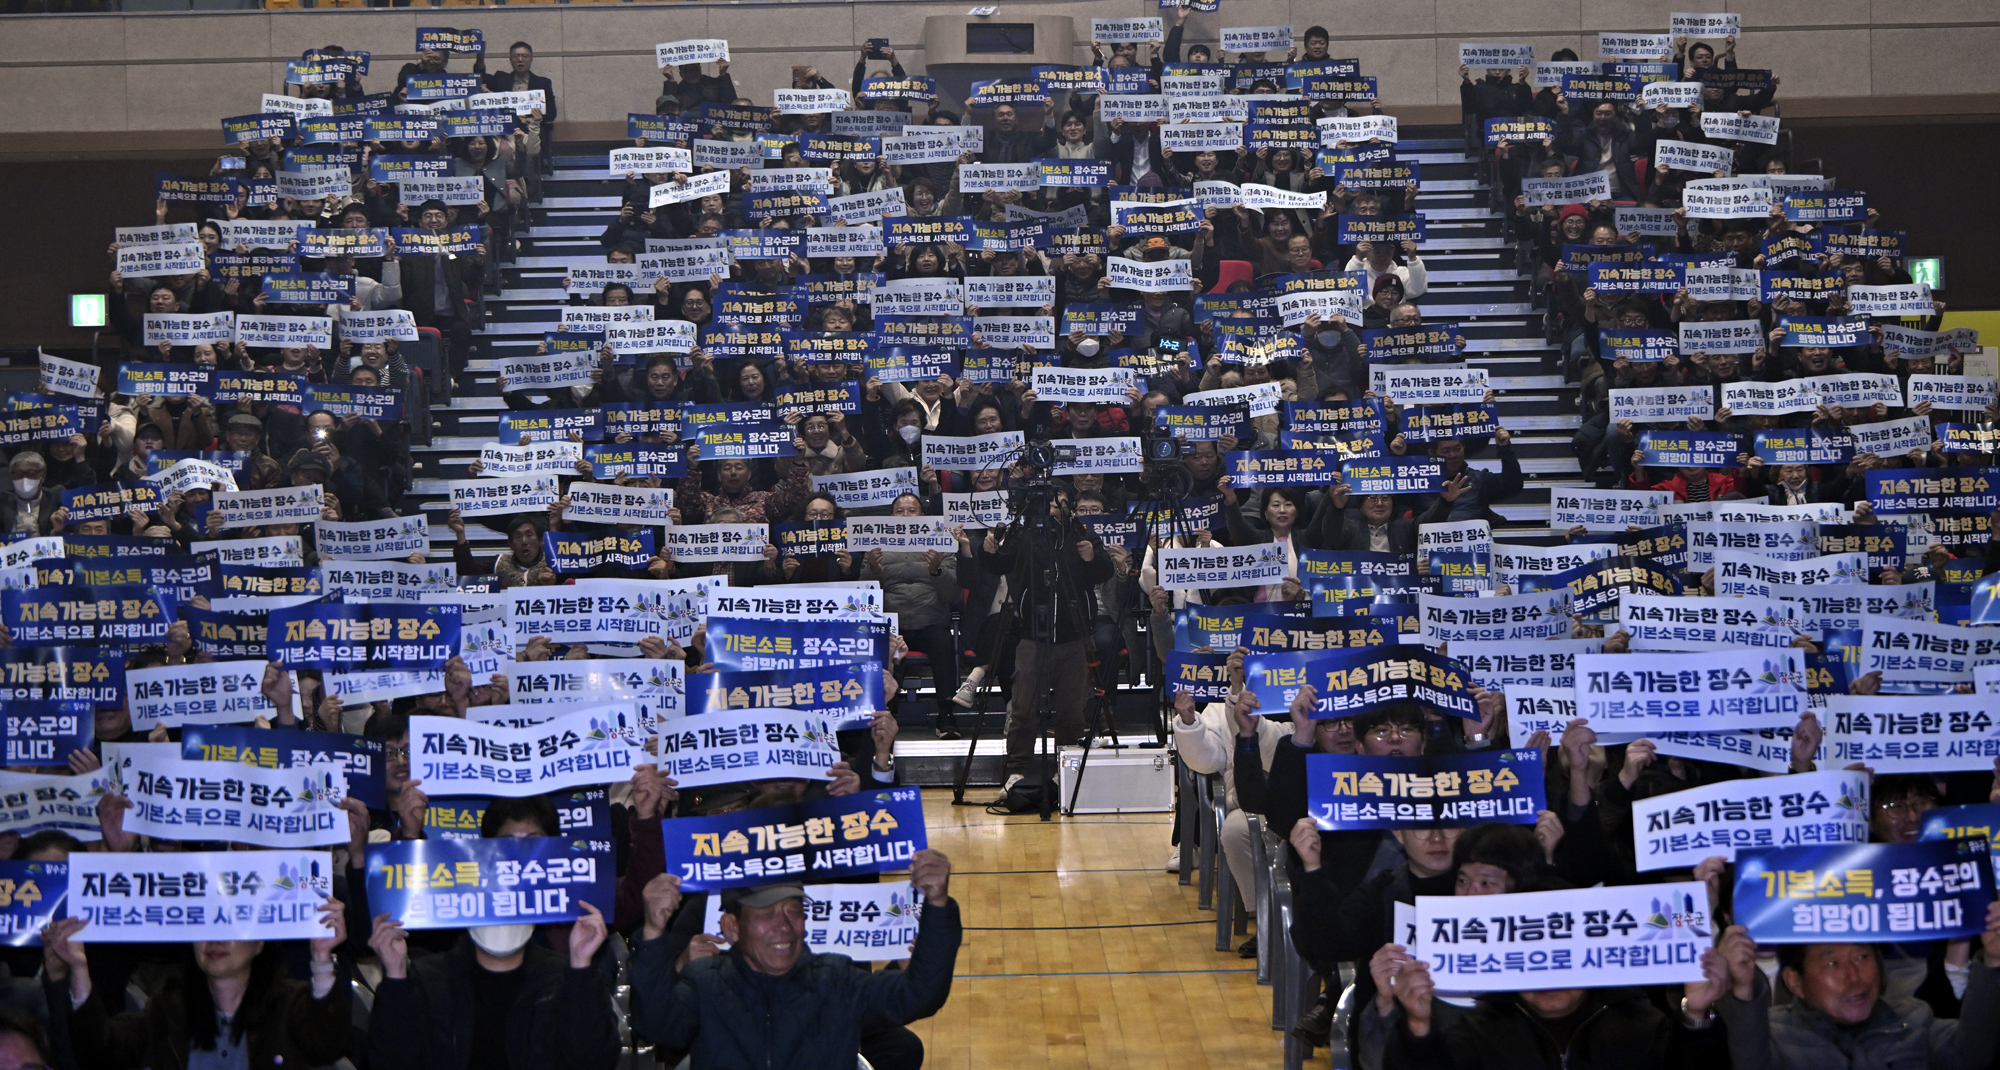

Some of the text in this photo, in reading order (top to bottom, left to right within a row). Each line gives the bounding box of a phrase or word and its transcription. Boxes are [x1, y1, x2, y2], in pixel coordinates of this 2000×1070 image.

[1673, 18, 1706, 26] 지속가능한
[1224, 31, 1275, 41] 지속가능한 장수
[614, 152, 671, 162] 지속가능한 장수
[614, 161, 688, 170] 기본소득으로 시작합니다
[963, 169, 1023, 178] 지속가능한 장수
[1006, 179, 1037, 187] 시작합니다
[1687, 195, 1749, 204] 지속가능한 장수
[892, 223, 963, 234] 지속가능한 장수
[888, 234, 969, 243] 기본소득으로 시작합니다
[1598, 269, 1675, 279] 지속가능한 장수
[1593, 281, 1681, 290] 기본소득으로 시작합니다
[241, 321, 307, 332] 지속가능한 장수
[884, 323, 963, 334] 지속가능한 장수
[240, 333, 326, 343] 기본소득으로 시작합니다
[879, 337, 968, 346] 기본소득으로 시작합니다
[126, 370, 208, 382] 기본소득, 장수군의
[1037, 374, 1108, 386] 지속가능한 장수
[1391, 376, 1463, 388] 지속가능한 장수
[135, 383, 196, 394] 희망이 됩니다
[1037, 387, 1084, 396] 기본소득으로
[1391, 388, 1484, 398] 기본소득으로 시작합니다
[703, 432, 790, 444] 기본소득, 장수군의
[1648, 440, 1737, 451] 기본소득, 장수군의
[714, 444, 779, 456] 희망이 됩니다
[1659, 452, 1725, 463] 희망이 됩니다
[1236, 459, 1324, 471] 지속가능한 장수
[1348, 466, 1440, 478] 기본소득, 장수군의
[1231, 472, 1331, 484] 기본소득으로 시작합니다
[1361, 479, 1429, 491] 희망이 됩니다
[1880, 477, 1989, 494] 지속가능한 장수
[454, 484, 531, 499] 지속가능한 장수
[456, 497, 554, 511] 기본소득으로 시작합니다
[1874, 496, 1997, 509] 기본소득으로 시작합니다
[319, 528, 398, 542] 지속가능한 장수
[319, 539, 423, 554] 기본소득으로 시작합니다
[1164, 553, 1256, 570] 지속가능한 장수
[1166, 567, 1281, 583] 기본소득으로 시작합니다
[20, 600, 159, 621] 지속가능한 장수
[515, 596, 630, 616] 지속가능한 장수
[1628, 606, 1758, 626] 지속가능한 장수
[11, 623, 168, 641] 기본소득으로 시작합니다
[286, 617, 441, 641] 지속가능한 장수
[515, 618, 660, 634] 기본소득으로 시작합니다
[722, 633, 874, 656] 기본소득, 장수군의
[1629, 626, 1792, 648] 기본소득으로 시작합니다
[276, 644, 450, 663] 기본소득으로 시작합니다
[1326, 659, 1463, 691] 지속가능한 장수
[1587, 668, 1753, 694] 지속가능한 장수
[1779, 672, 1802, 683] 장수군
[1318, 682, 1474, 713] 기본소득으로 시작합니다
[1588, 696, 1798, 719] 기본소득으로 시작합니다
[1835, 711, 1992, 734] 지속가능한 장수
[609, 726, 636, 739] 장수군
[664, 723, 799, 754] 지속가능한 장수
[423, 730, 581, 762] 지속가능한 장수
[1835, 742, 1939, 760] 기본소득으로
[664, 750, 834, 776] 기본소득으로 시작합니다
[1515, 751, 1537, 761] 장수군
[423, 750, 630, 783] 기본소득으로 시작합니다
[138, 770, 293, 808] 지속가능한 장수
[1332, 767, 1519, 796] 지속가능한 장수
[892, 791, 916, 801] 장수군
[1321, 797, 1534, 821] 기본소득으로 시작합니다
[1647, 790, 1830, 833] 지속가능한 장수
[136, 802, 336, 834] 기본소득으로 시작합니다
[692, 809, 898, 857] 지속가능한 장수
[589, 841, 611, 852] 장수군
[1649, 828, 1772, 855] 기본소득으로
[681, 840, 916, 882] 기본소득으로 시작합니다
[381, 858, 596, 889] 기본소득, 장수군의
[1759, 861, 1981, 899] 기본소득, 장수군의
[83, 872, 207, 897] 지속가능한
[299, 876, 329, 890] 장수군
[408, 888, 569, 918] 희망이 됩니다
[82, 906, 205, 925] 기본소득으로
[1671, 913, 1705, 927] 장수군
[1792, 899, 1964, 933] 희망이 됩니다
[1432, 909, 1638, 944] 지속가능한 장수
[1432, 942, 1697, 974] 기본소득으로 시작합니다
